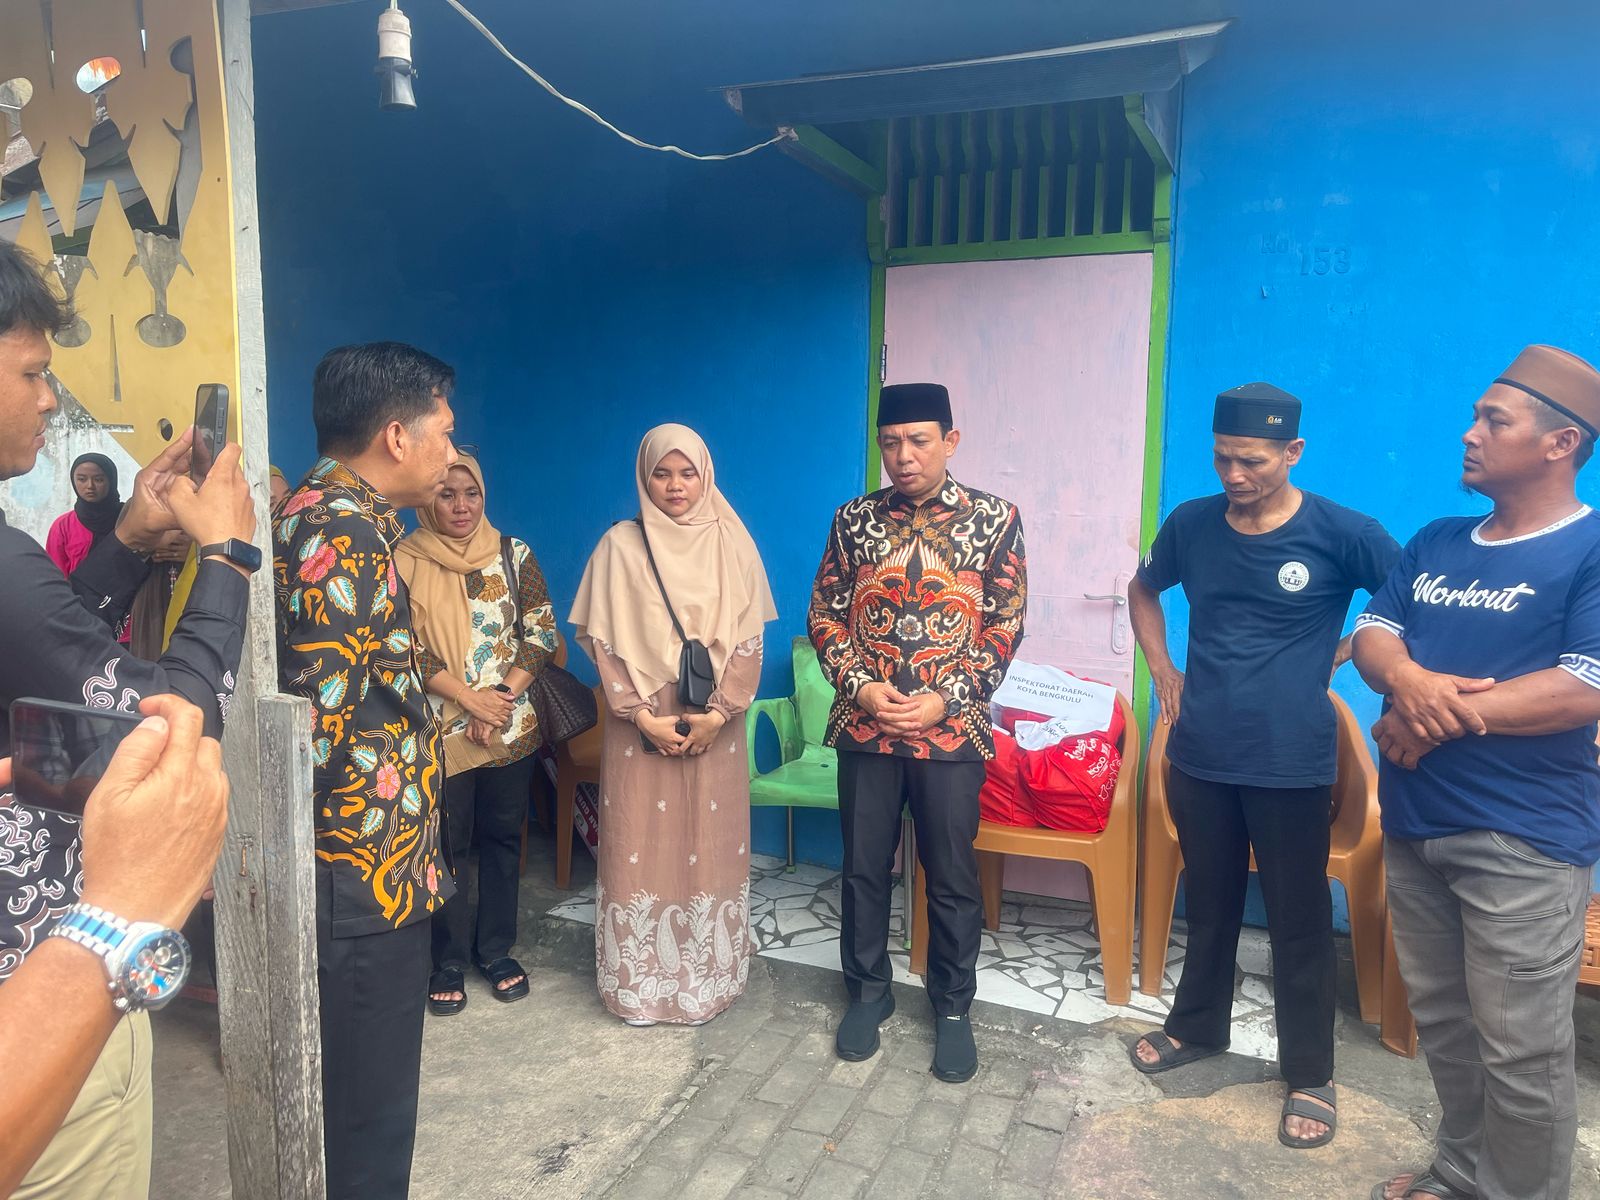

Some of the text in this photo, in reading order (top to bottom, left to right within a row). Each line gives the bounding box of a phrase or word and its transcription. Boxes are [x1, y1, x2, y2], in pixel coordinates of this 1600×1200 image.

[1299, 242, 1350, 276] 153
[1412, 572, 1536, 613] Workout
[1009, 675, 1093, 699] INSPEKTORAT DAERAH
[1016, 684, 1082, 704] KOTA BENGKULU
